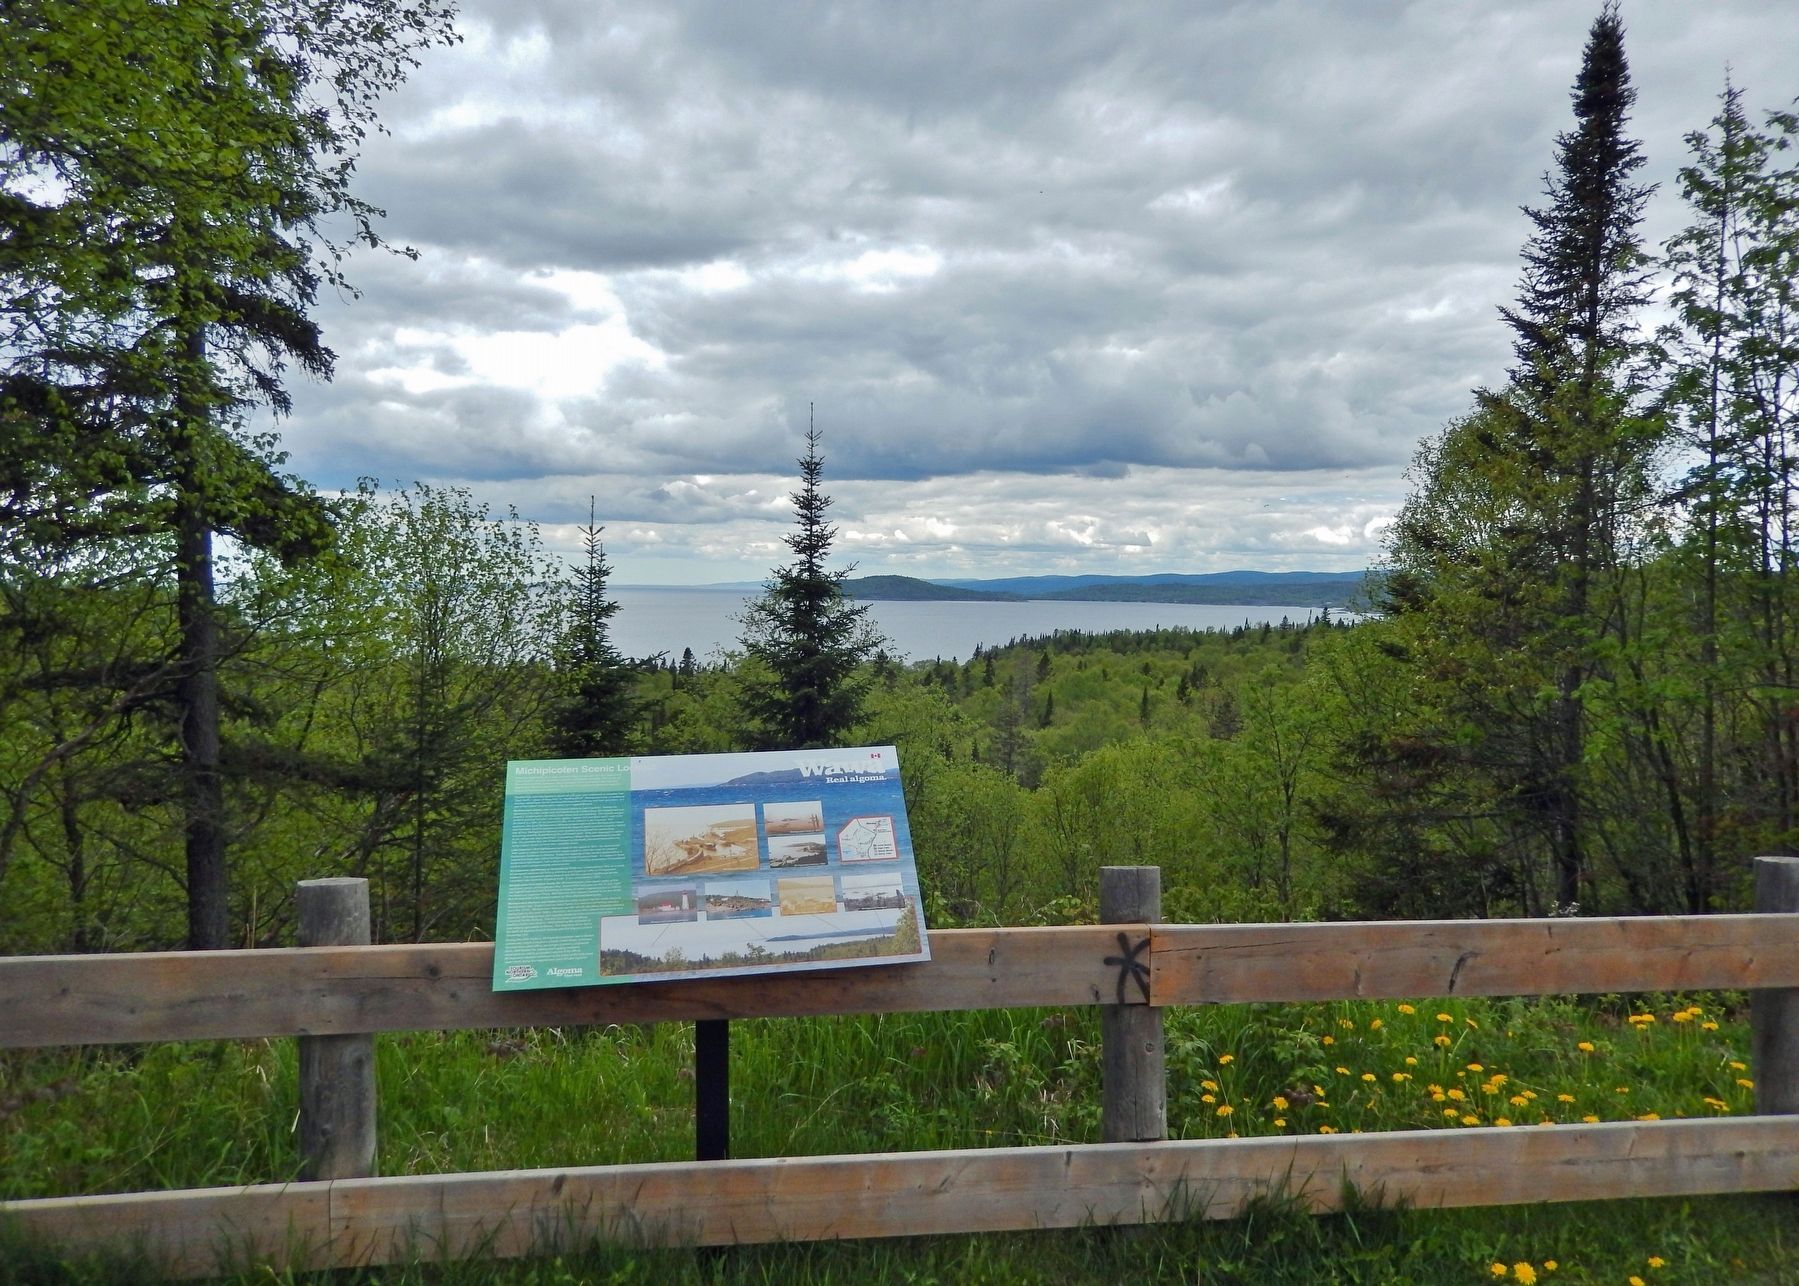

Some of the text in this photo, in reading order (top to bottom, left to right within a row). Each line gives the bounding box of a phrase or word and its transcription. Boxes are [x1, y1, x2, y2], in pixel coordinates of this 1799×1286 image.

[515, 766, 578, 776] Michipicoten
[581, 764, 615, 773] Scenic
[546, 968, 583, 976] Algoma
